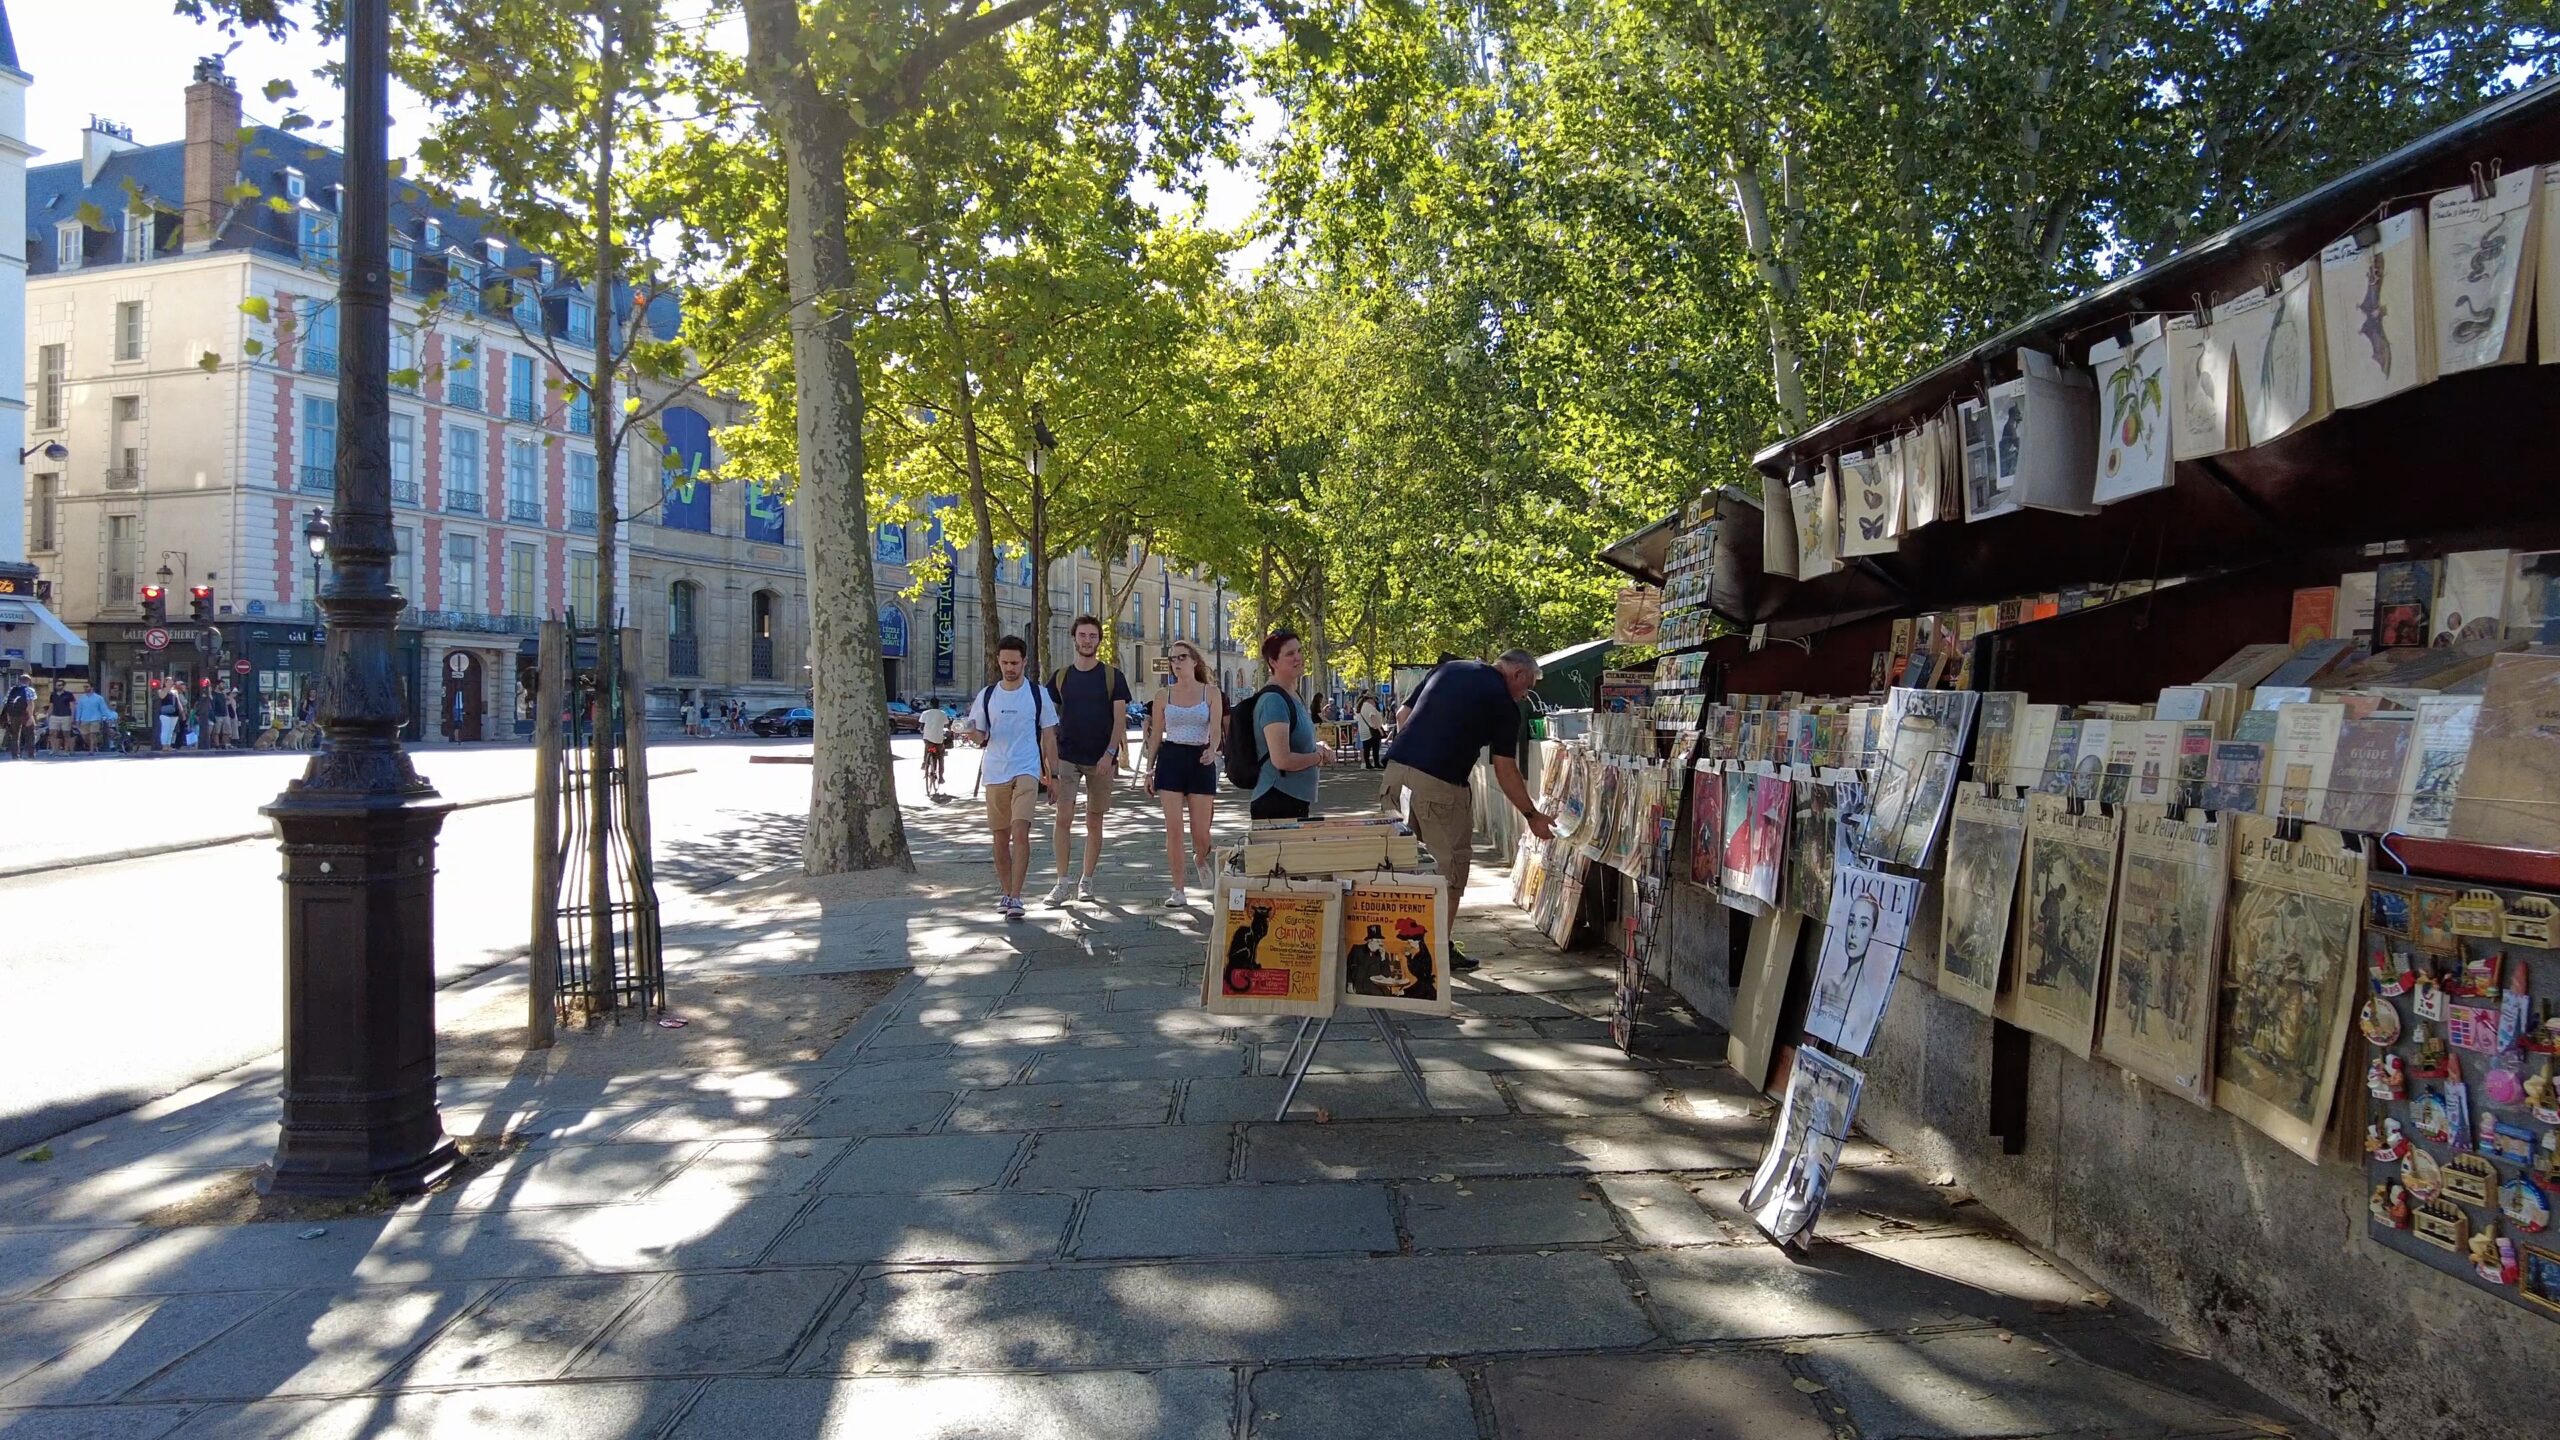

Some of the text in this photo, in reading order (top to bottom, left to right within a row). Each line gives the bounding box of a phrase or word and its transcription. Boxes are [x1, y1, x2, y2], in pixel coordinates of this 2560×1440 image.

[2350, 748, 2390, 760] GUIDE
[2240, 833, 2254, 856] Le
[2298, 845, 2358, 878] Journal
[1841, 871, 1906, 914] VOGUE
[1399, 903, 1426, 913] PERNOT
